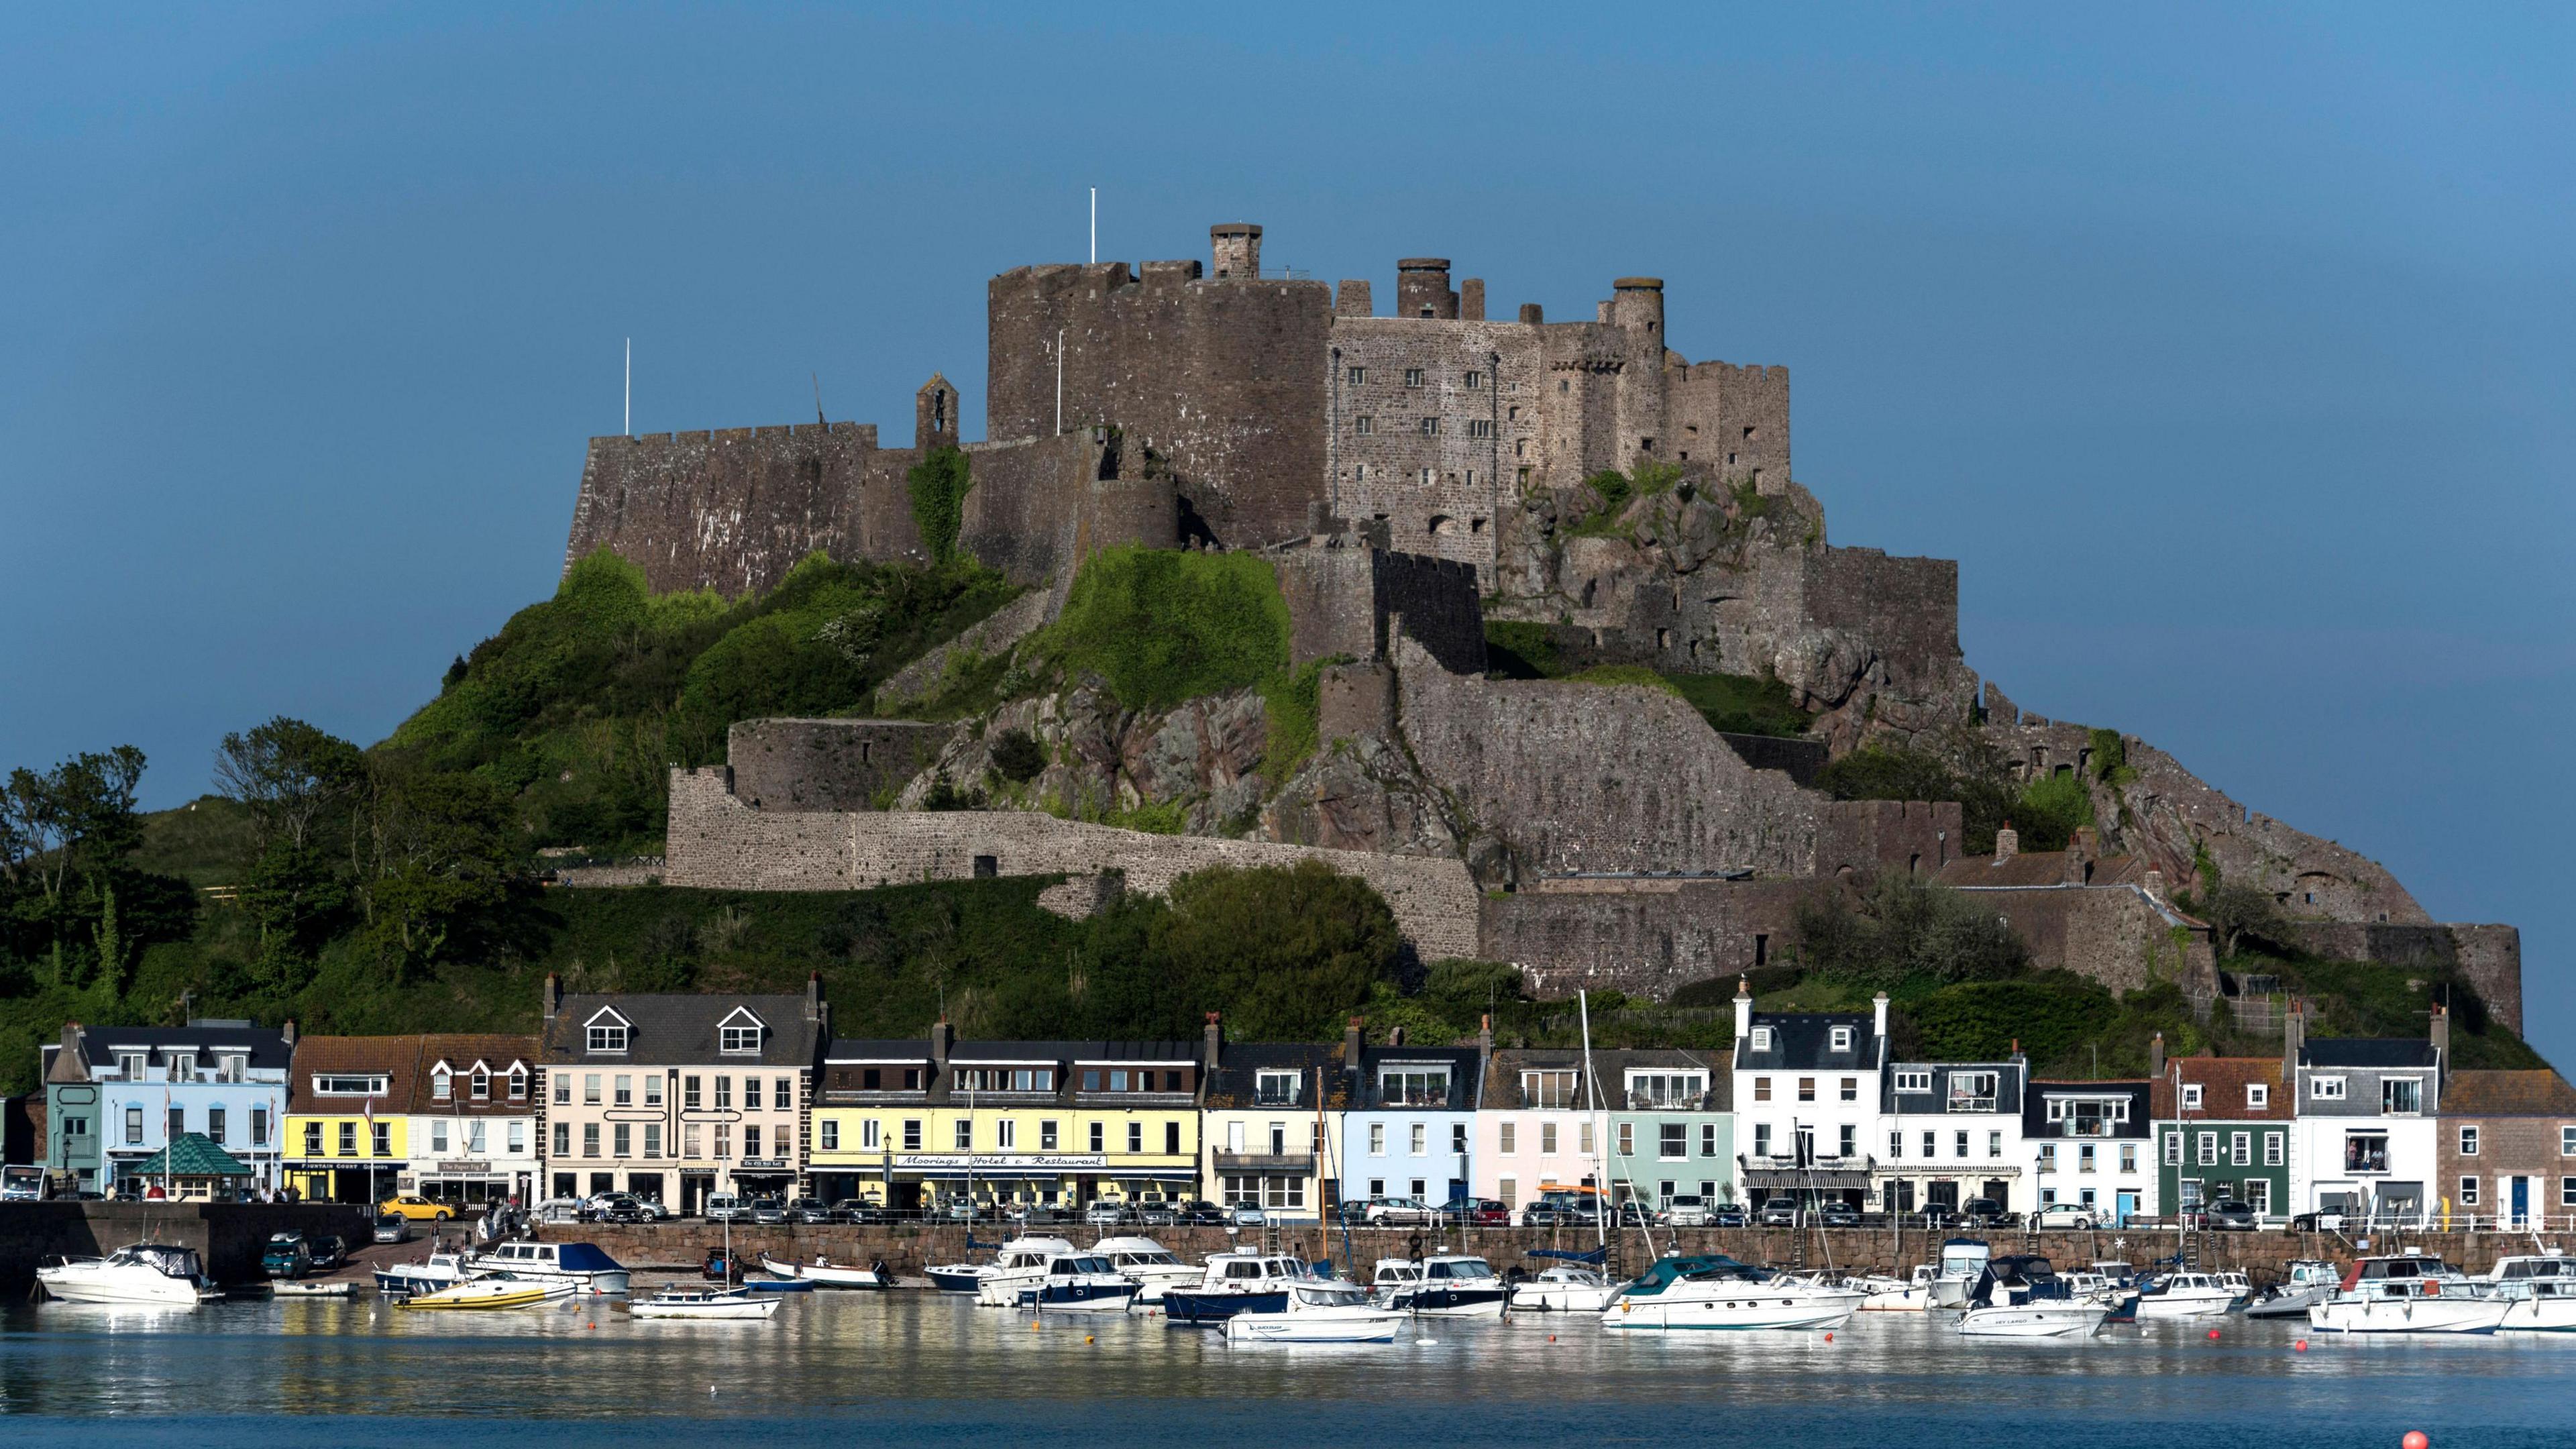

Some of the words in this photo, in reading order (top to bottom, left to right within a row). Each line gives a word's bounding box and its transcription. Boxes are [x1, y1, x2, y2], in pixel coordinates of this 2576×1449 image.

[902, 1156, 959, 1166] Moorings
[968, 1157, 1007, 1165] Hotel
[1032, 1157, 1103, 1165] Restaurant
[454, 1163, 469, 1171] Paper
